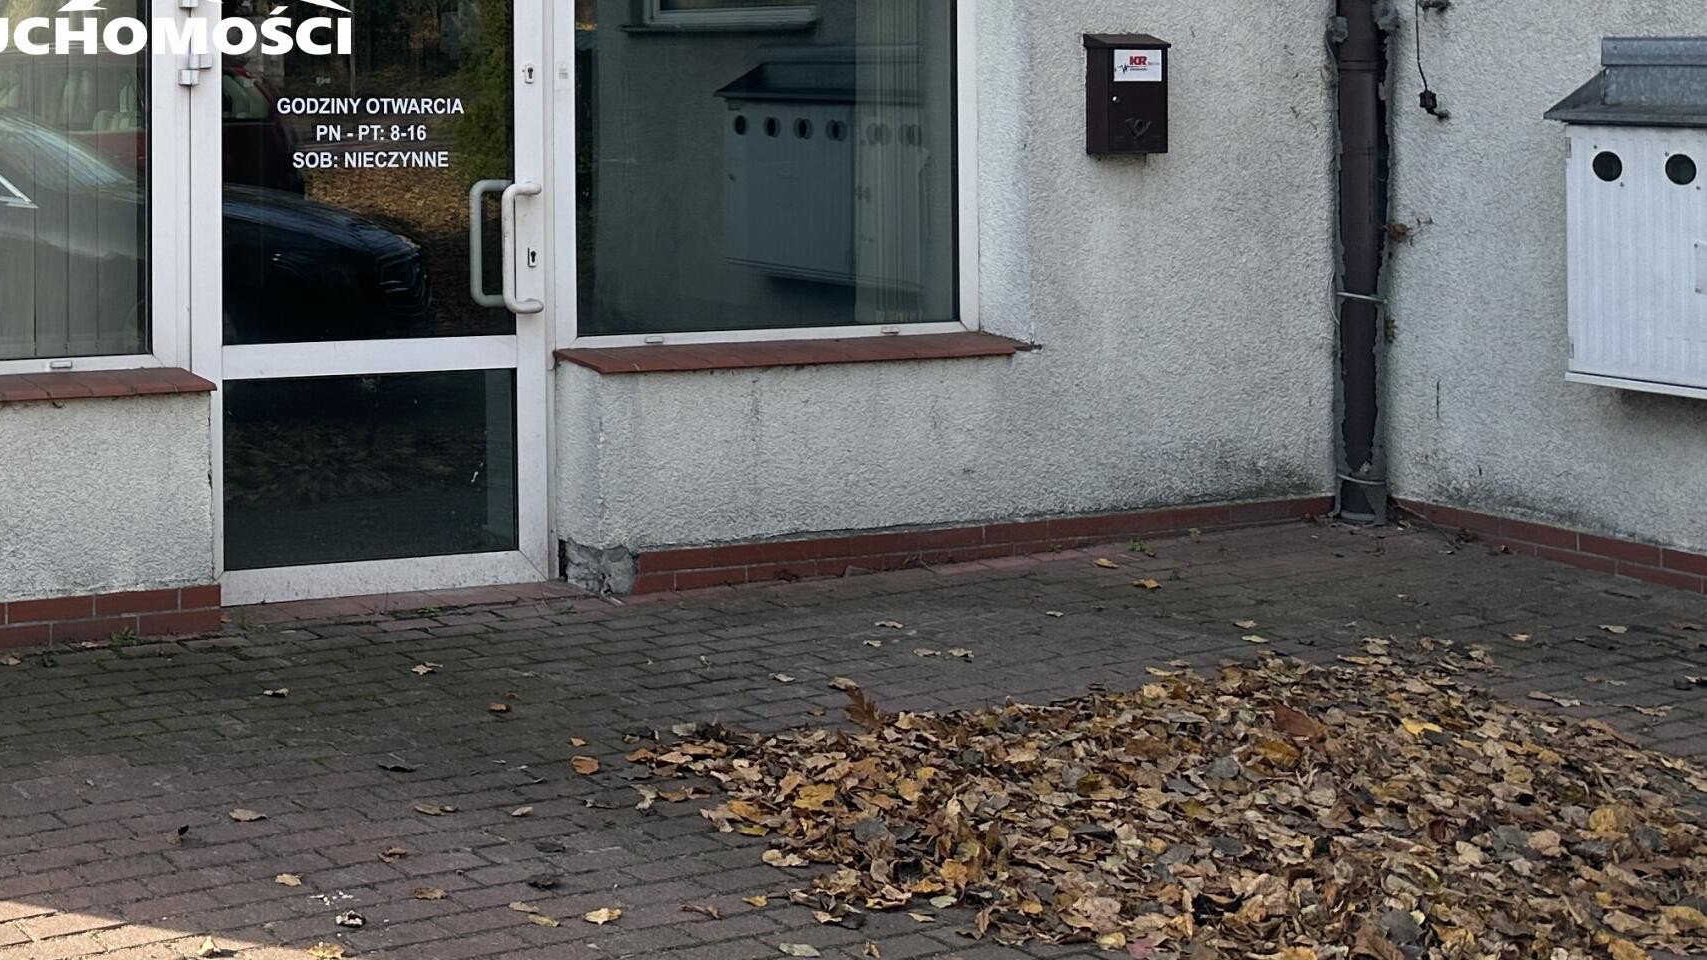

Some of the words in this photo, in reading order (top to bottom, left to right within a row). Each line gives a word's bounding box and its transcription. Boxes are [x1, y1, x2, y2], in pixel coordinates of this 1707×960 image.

[277, 97, 361, 115] GODZINY
[365, 97, 465, 115] OTWARCIA
[316, 124, 341, 141] PN
[358, 124, 385, 141] PT:
[390, 124, 427, 141] 8-16
[292, 151, 338, 169] SOB:
[344, 151, 449, 168] NIECZYNNE
